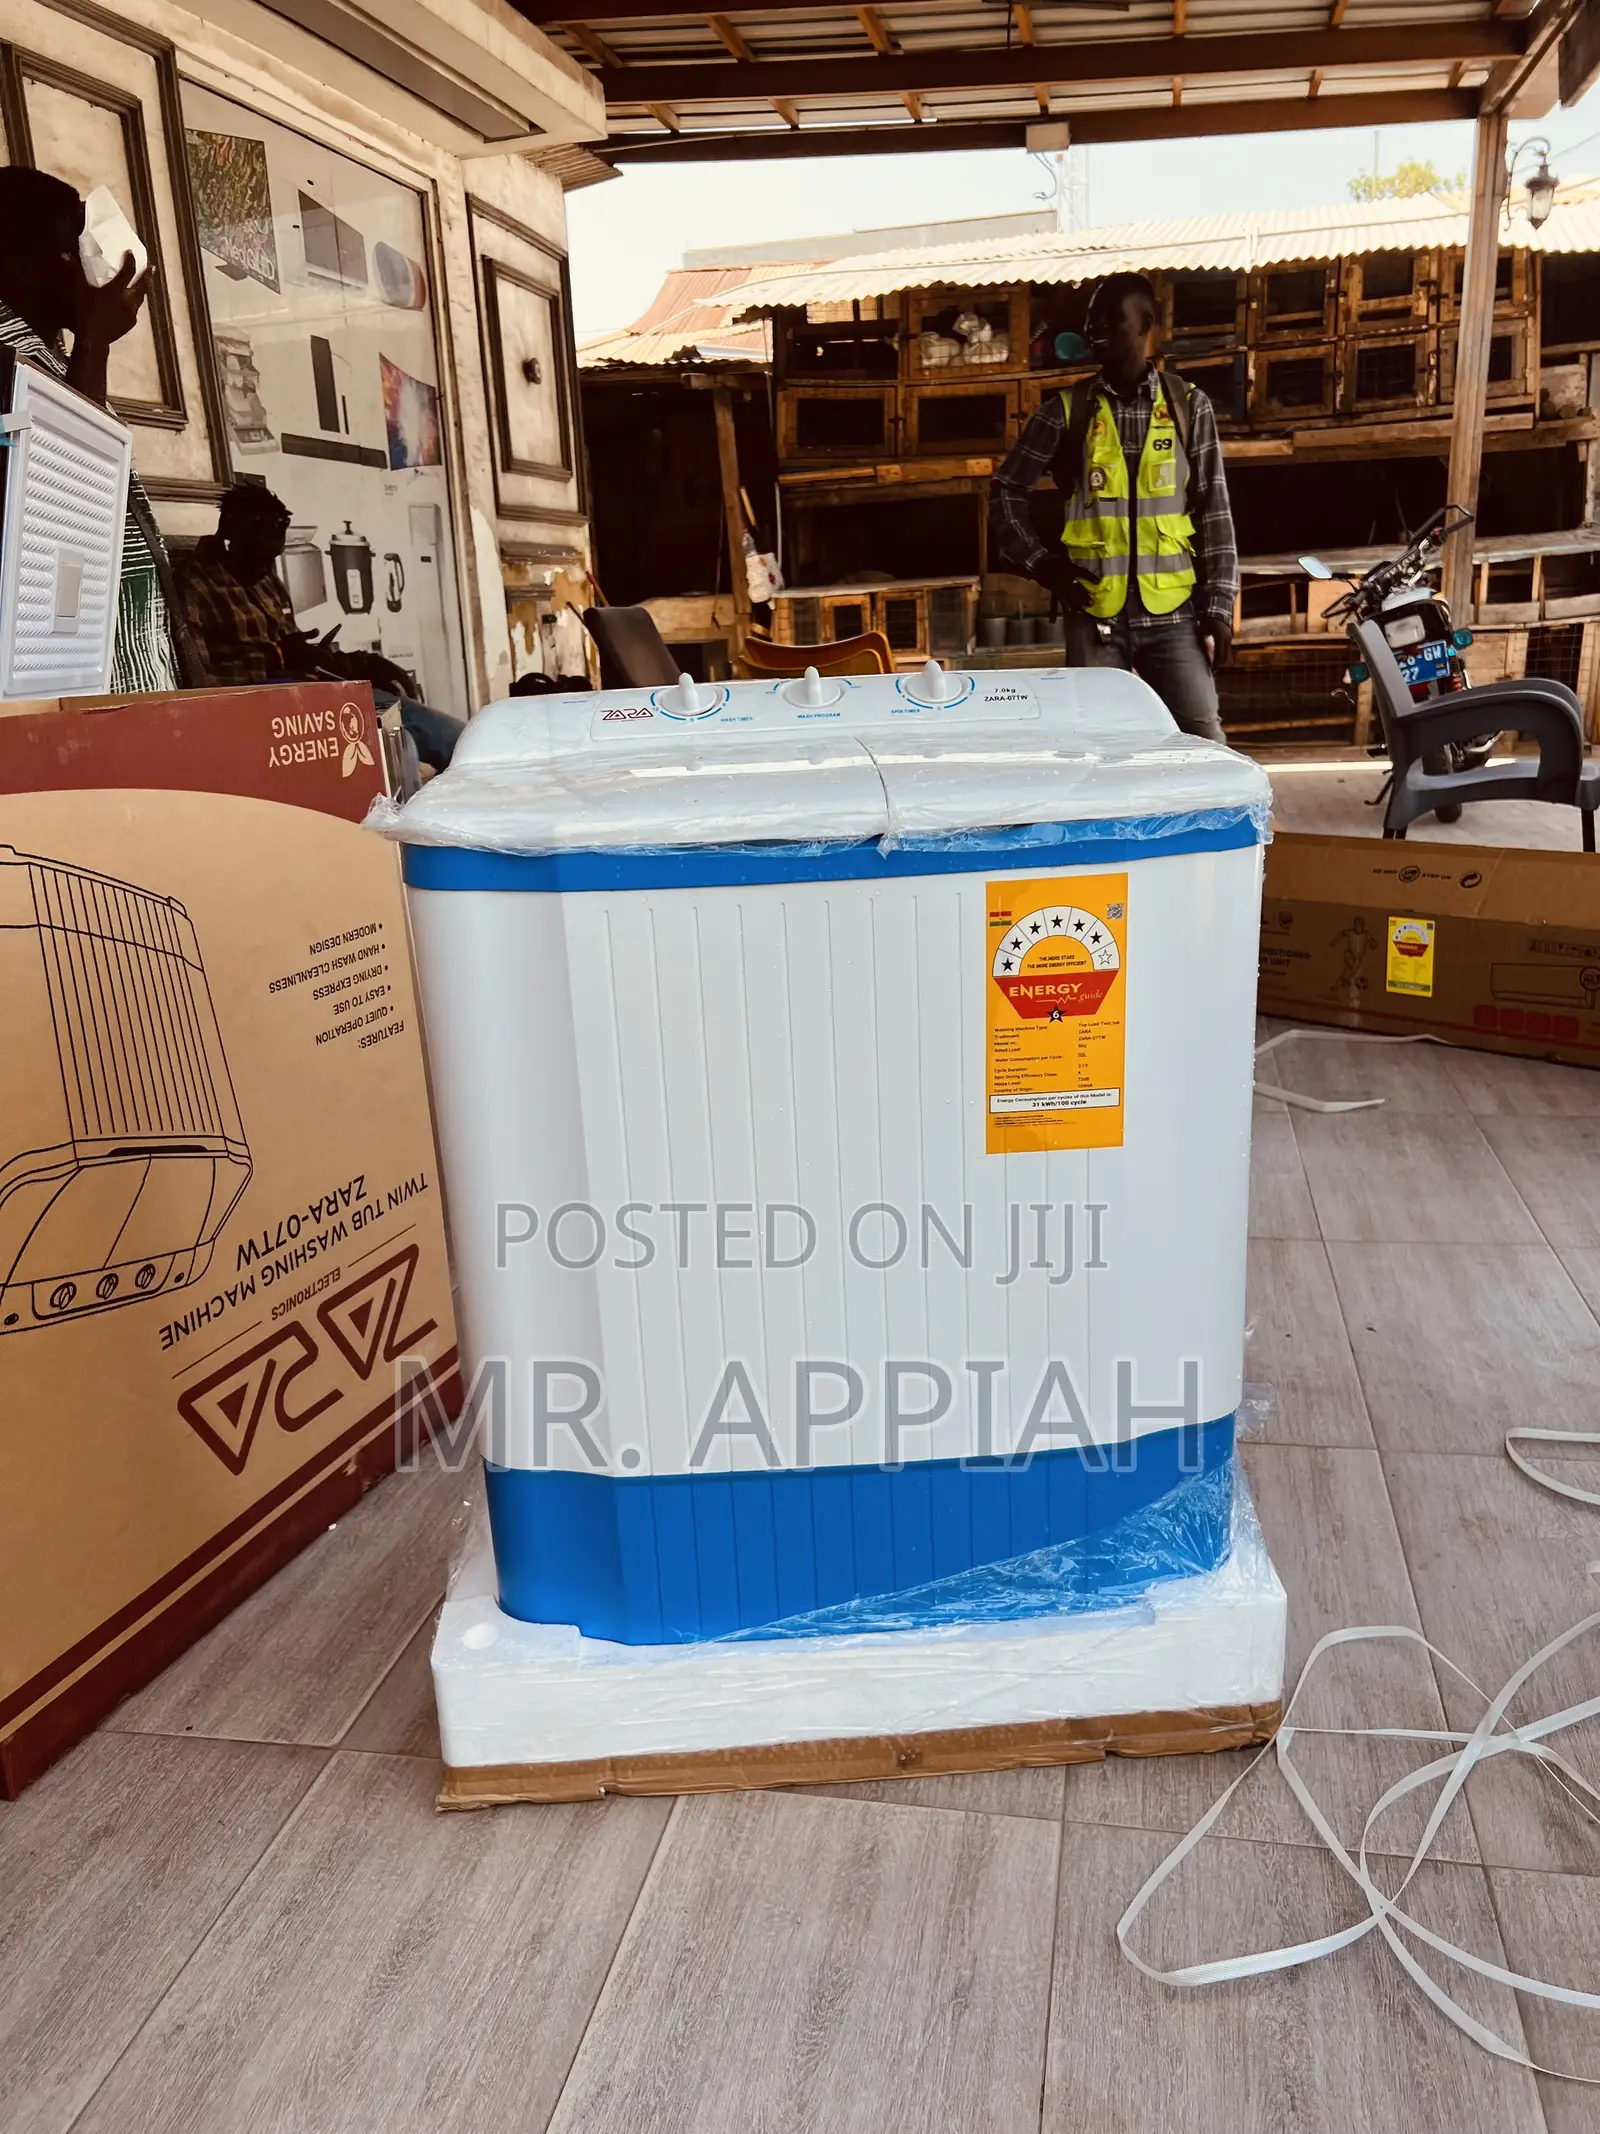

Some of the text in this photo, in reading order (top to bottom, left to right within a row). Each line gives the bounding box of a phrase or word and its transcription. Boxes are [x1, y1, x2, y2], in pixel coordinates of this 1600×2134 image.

[1153, 438, 1172, 451] 69
[272, 711, 335, 738] SAVING
[601, 708, 653, 721] ZARA
[269, 737, 339, 767] ENERGY
[310, 923, 376, 955] MODERN DESIGN
[269, 944, 379, 993] HAND WASH CLEANLINESS
[313, 965, 382, 1000] DRYING EXPRESS
[333, 986, 385, 1015] EASY TO USE
[1010, 983, 1082, 999] ENERGY
[1079, 990, 1102, 1002] guide
[316, 1006, 387, 1045] QUIET OPERATION
[1052, 1010, 1060, 1018] 6
[358, 1020, 404, 1048] FEATURES:
[237, 1175, 367, 1271] ZARA-07TW
[159, 1173, 427, 1351] TWIN TUB WASHING MACHINE
[271, 1267, 341, 1320] ELECTRONICS
[177, 1243, 438, 1475] ZARA
